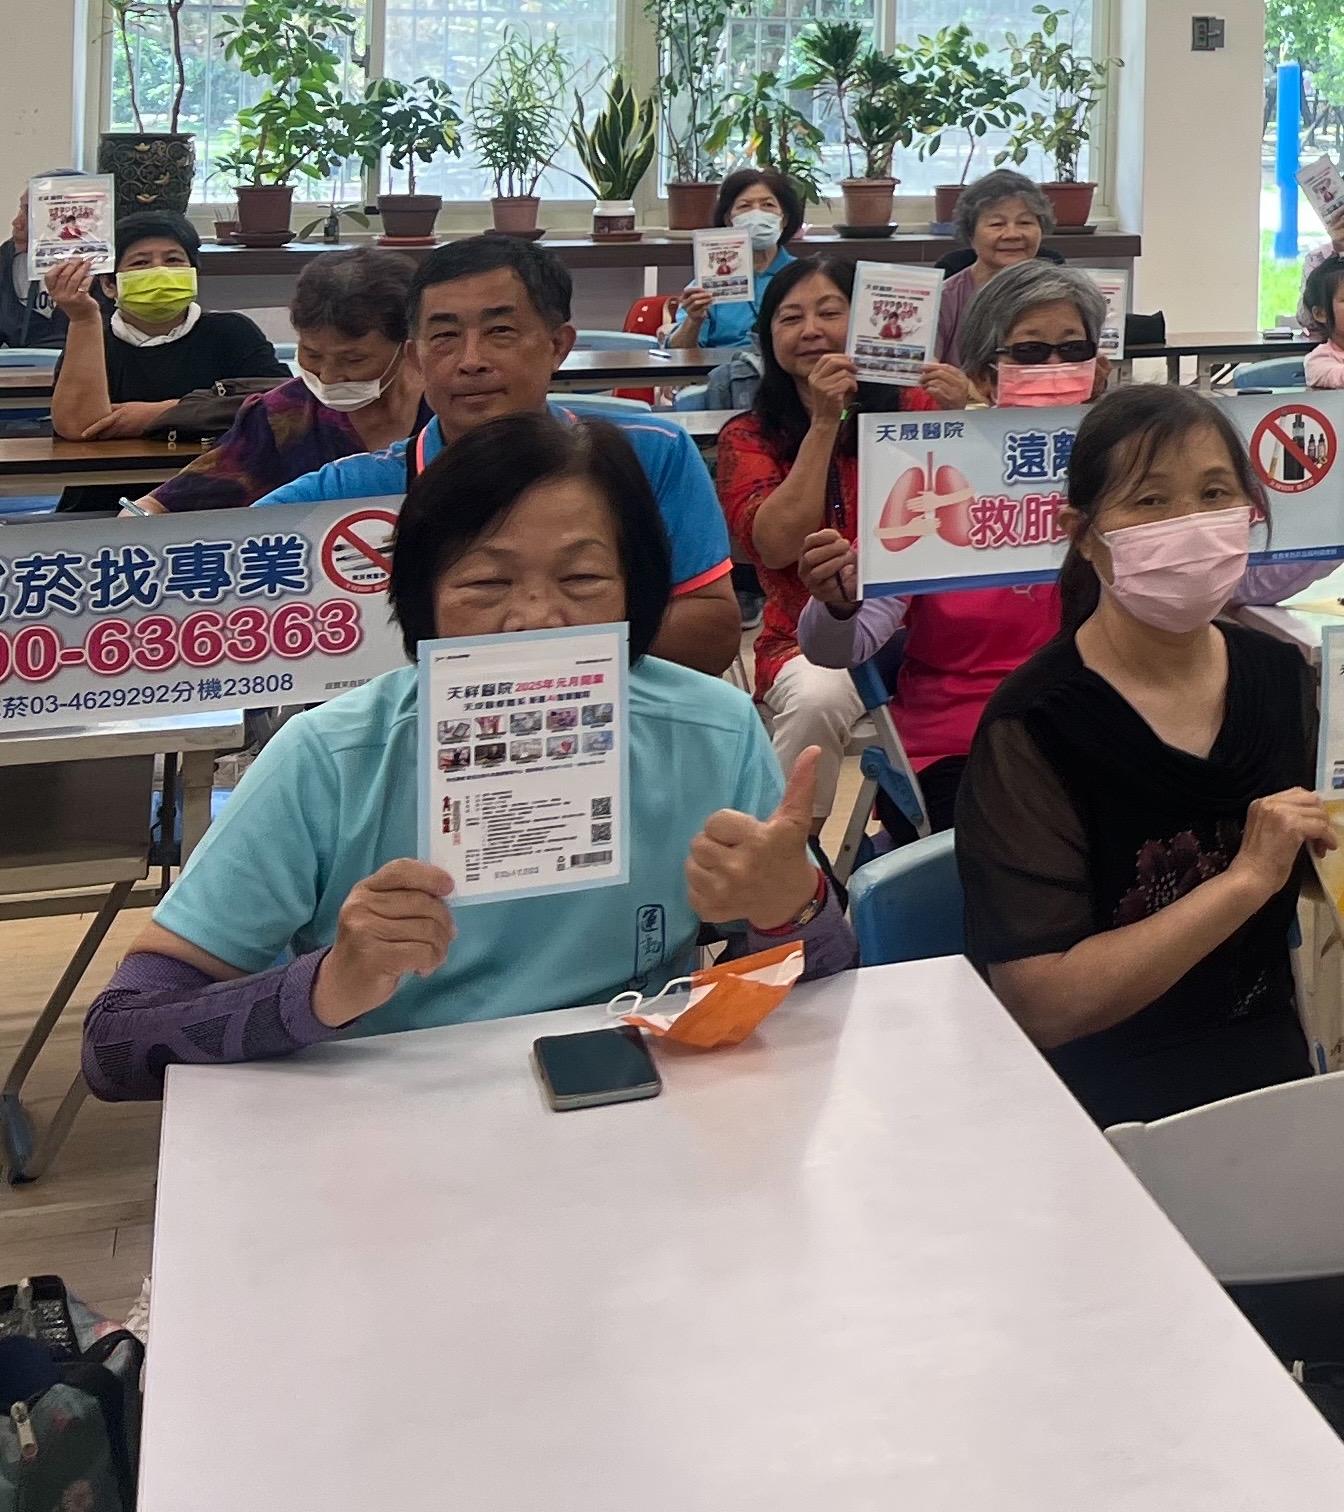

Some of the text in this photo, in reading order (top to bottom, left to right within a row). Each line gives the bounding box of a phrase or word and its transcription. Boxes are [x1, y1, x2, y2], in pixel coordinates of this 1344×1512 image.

[875, 421, 965, 443] 天晟醫院
[0, 535, 306, 618] 菸找專業
[0, 672, 293, 720] 菸03-4629292分機23808
[446, 681, 515, 701] 天祥醫院
